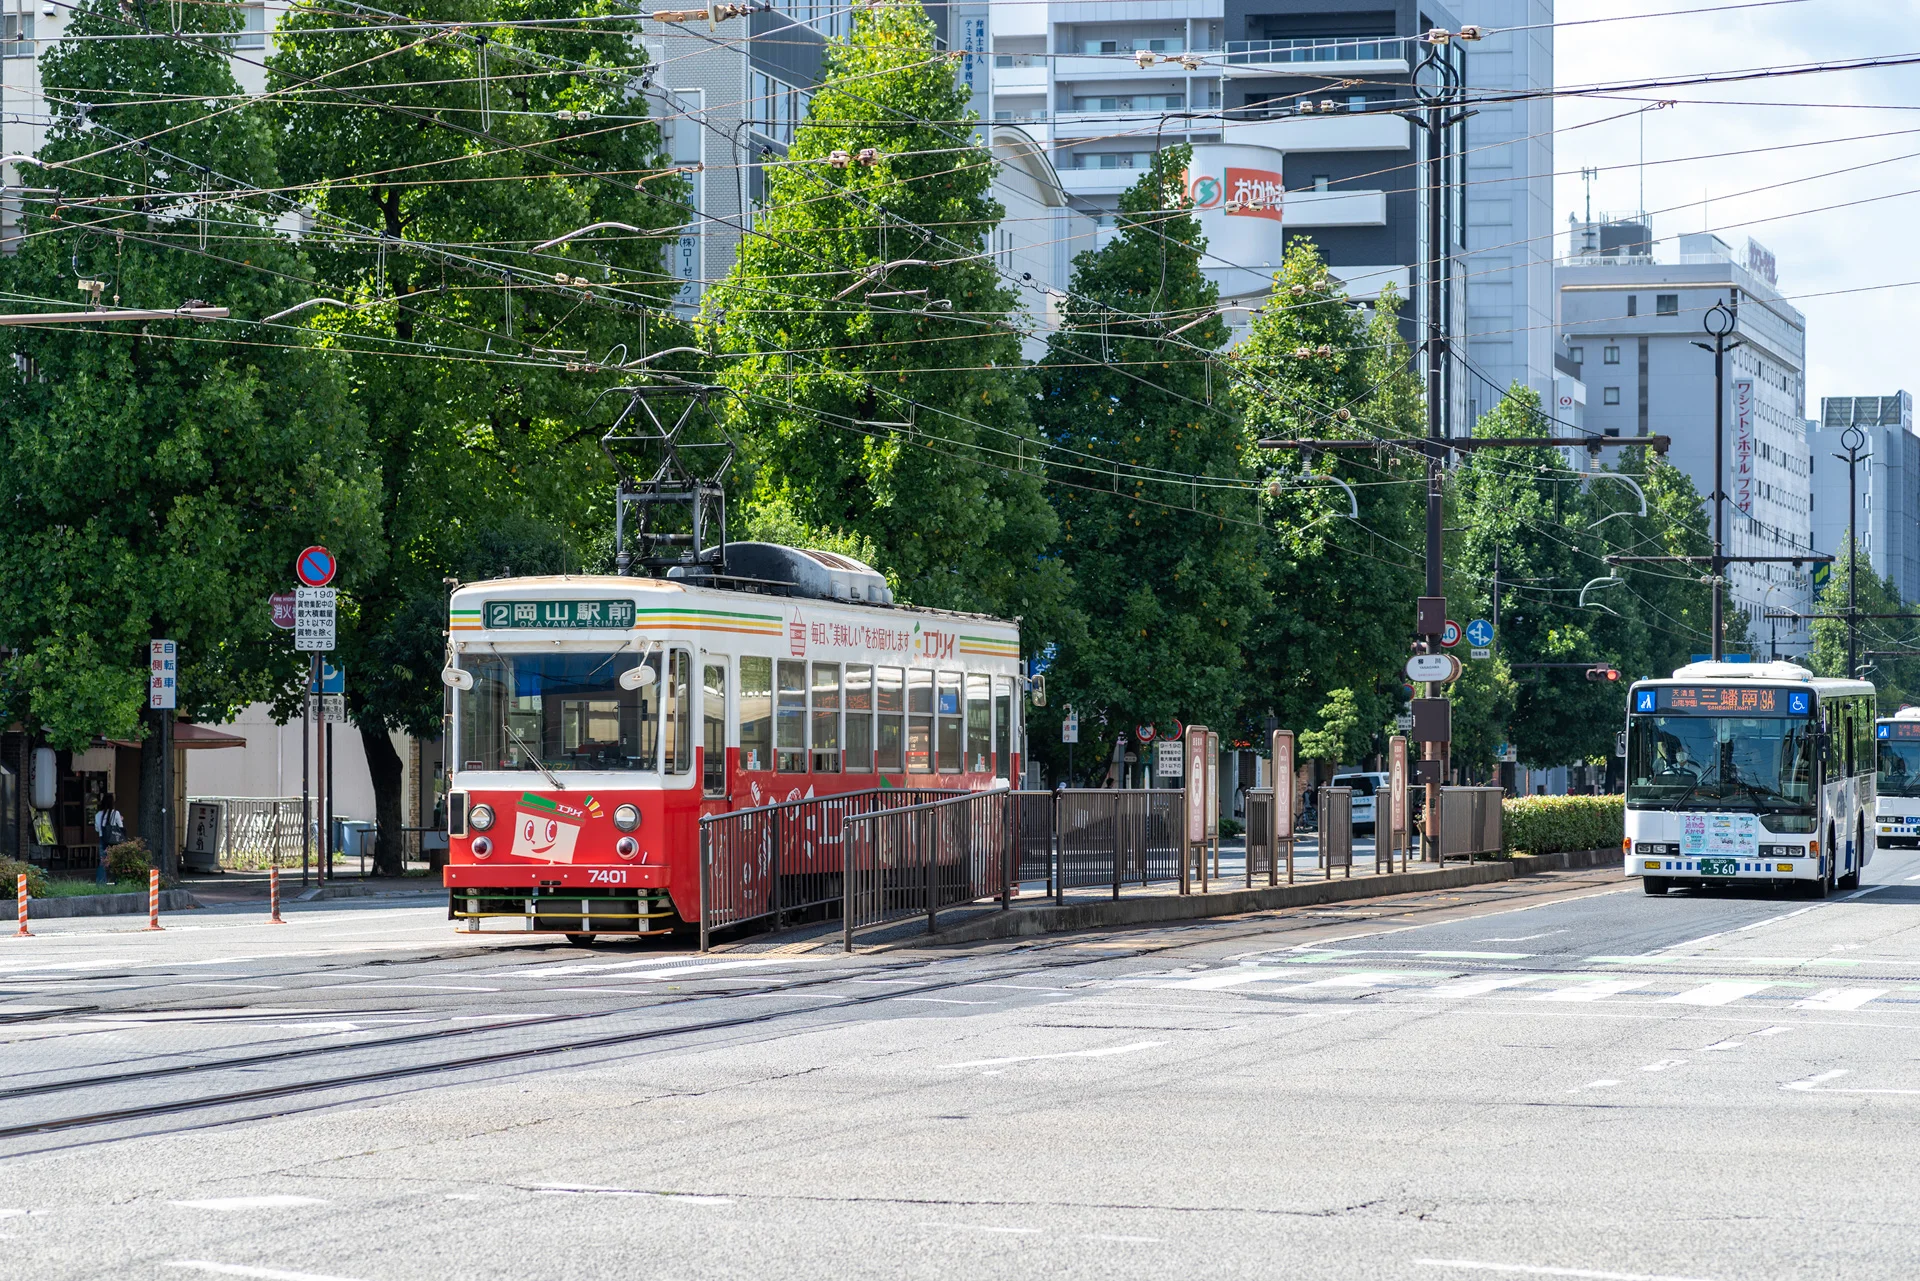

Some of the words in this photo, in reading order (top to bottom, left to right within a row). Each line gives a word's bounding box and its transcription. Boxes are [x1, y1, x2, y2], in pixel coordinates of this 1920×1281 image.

[976, 20, 984, 64] 弁護士法人
[493, 605, 508, 625] 2
[514, 602, 632, 621] 岡山駅前
[520, 620, 629, 628] OKAYAMA-EKIMAE
[152, 643, 162, 706] 左側通行
[164, 643, 174, 688] 自転車
[588, 869, 627, 883] 7401
